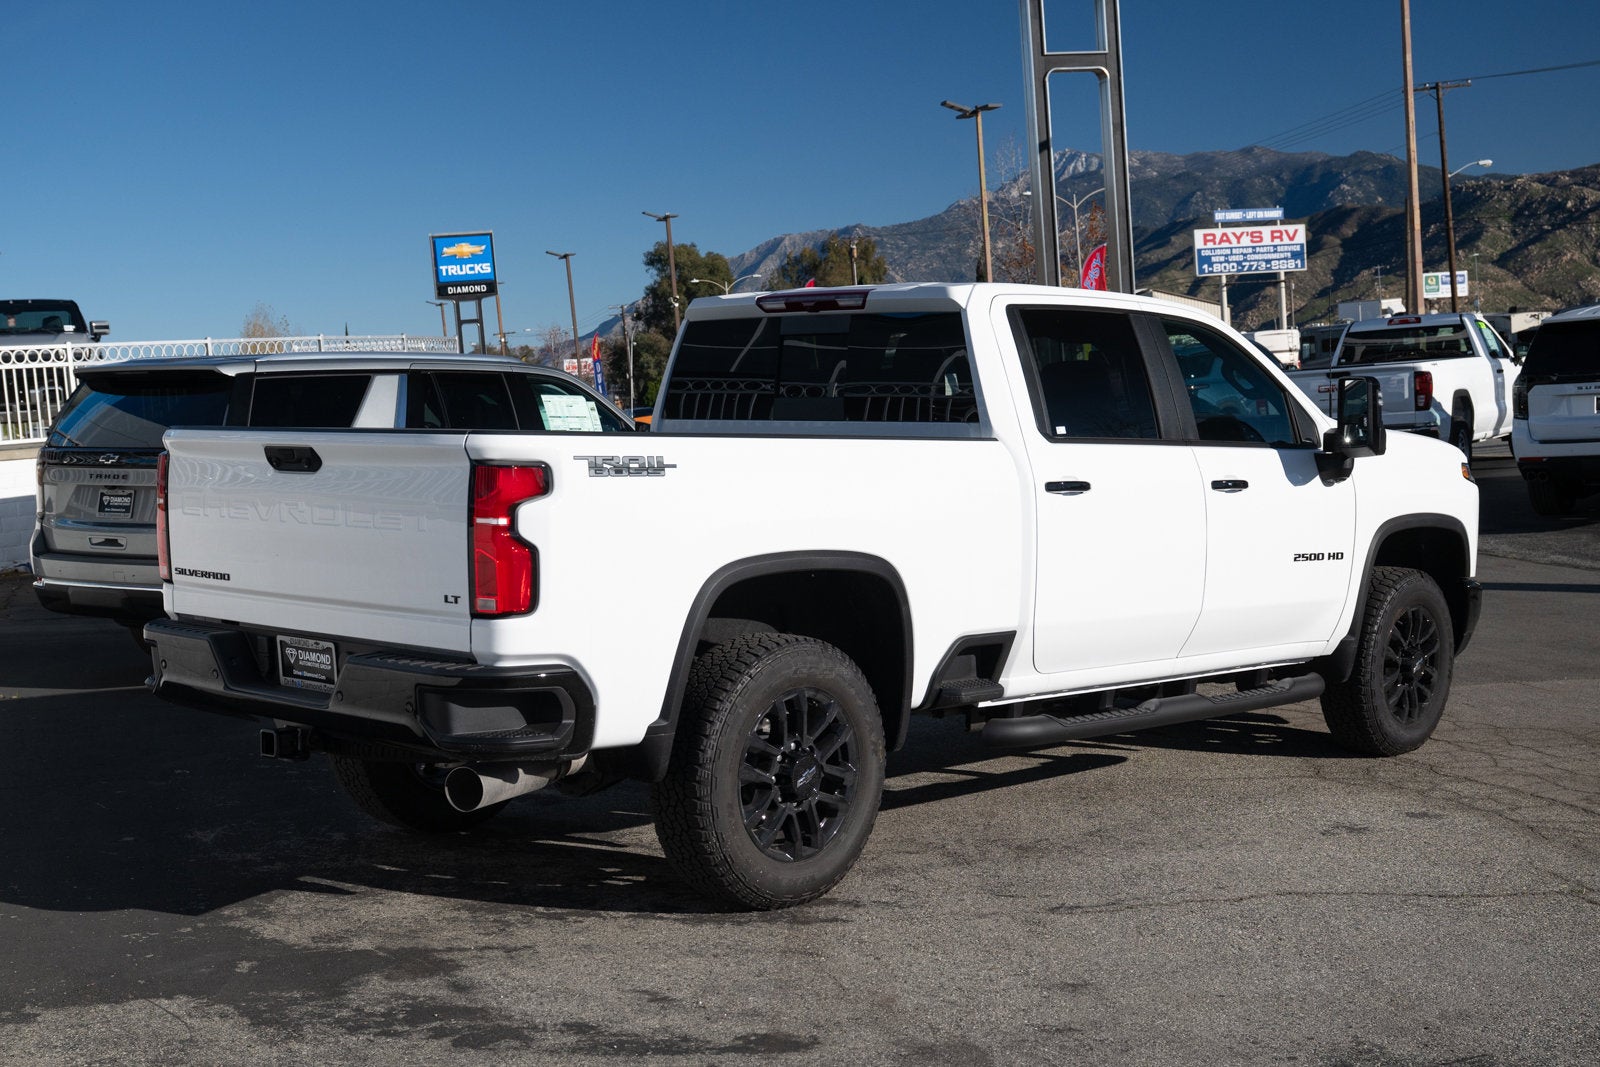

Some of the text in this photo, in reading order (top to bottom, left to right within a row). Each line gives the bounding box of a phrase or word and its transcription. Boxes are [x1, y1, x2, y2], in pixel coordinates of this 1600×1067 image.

[1203, 228, 1299, 246] RAY'S RV
[1247, 252, 1291, 260] CONSIGNMENTS
[440, 262, 491, 276] TRUCKS
[448, 284, 487, 294] DIAMOND
[573, 456, 677, 468] TRAIL
[589, 467, 665, 477] BOSS
[182, 490, 434, 532] CHEVROLET
[1294, 552, 1344, 562] 2500 HD
[175, 567, 231, 581] SILVERADO
[444, 594, 461, 604] LT
[298, 650, 331, 665] DIAMOND
